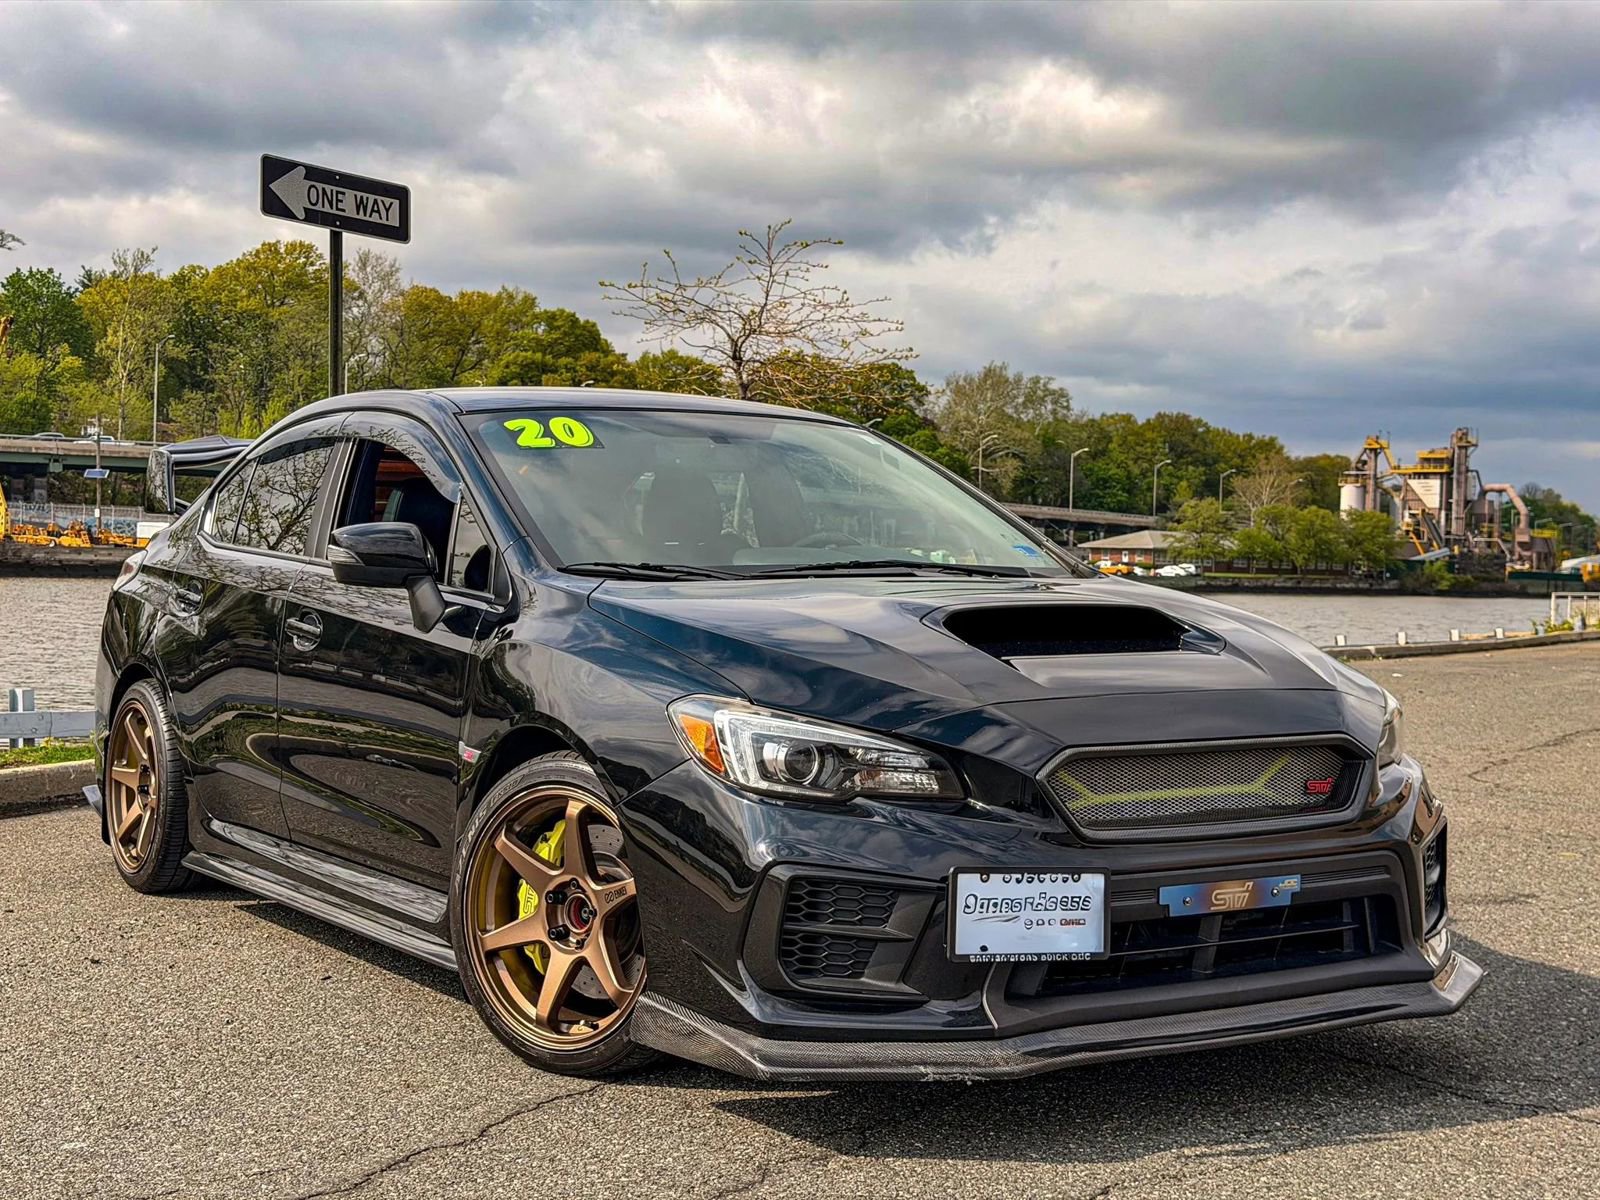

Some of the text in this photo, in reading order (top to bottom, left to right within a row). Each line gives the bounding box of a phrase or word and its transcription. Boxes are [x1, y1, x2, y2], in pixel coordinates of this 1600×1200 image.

[307, 184, 393, 221] ONE WAY
[503, 416, 594, 448] 20
